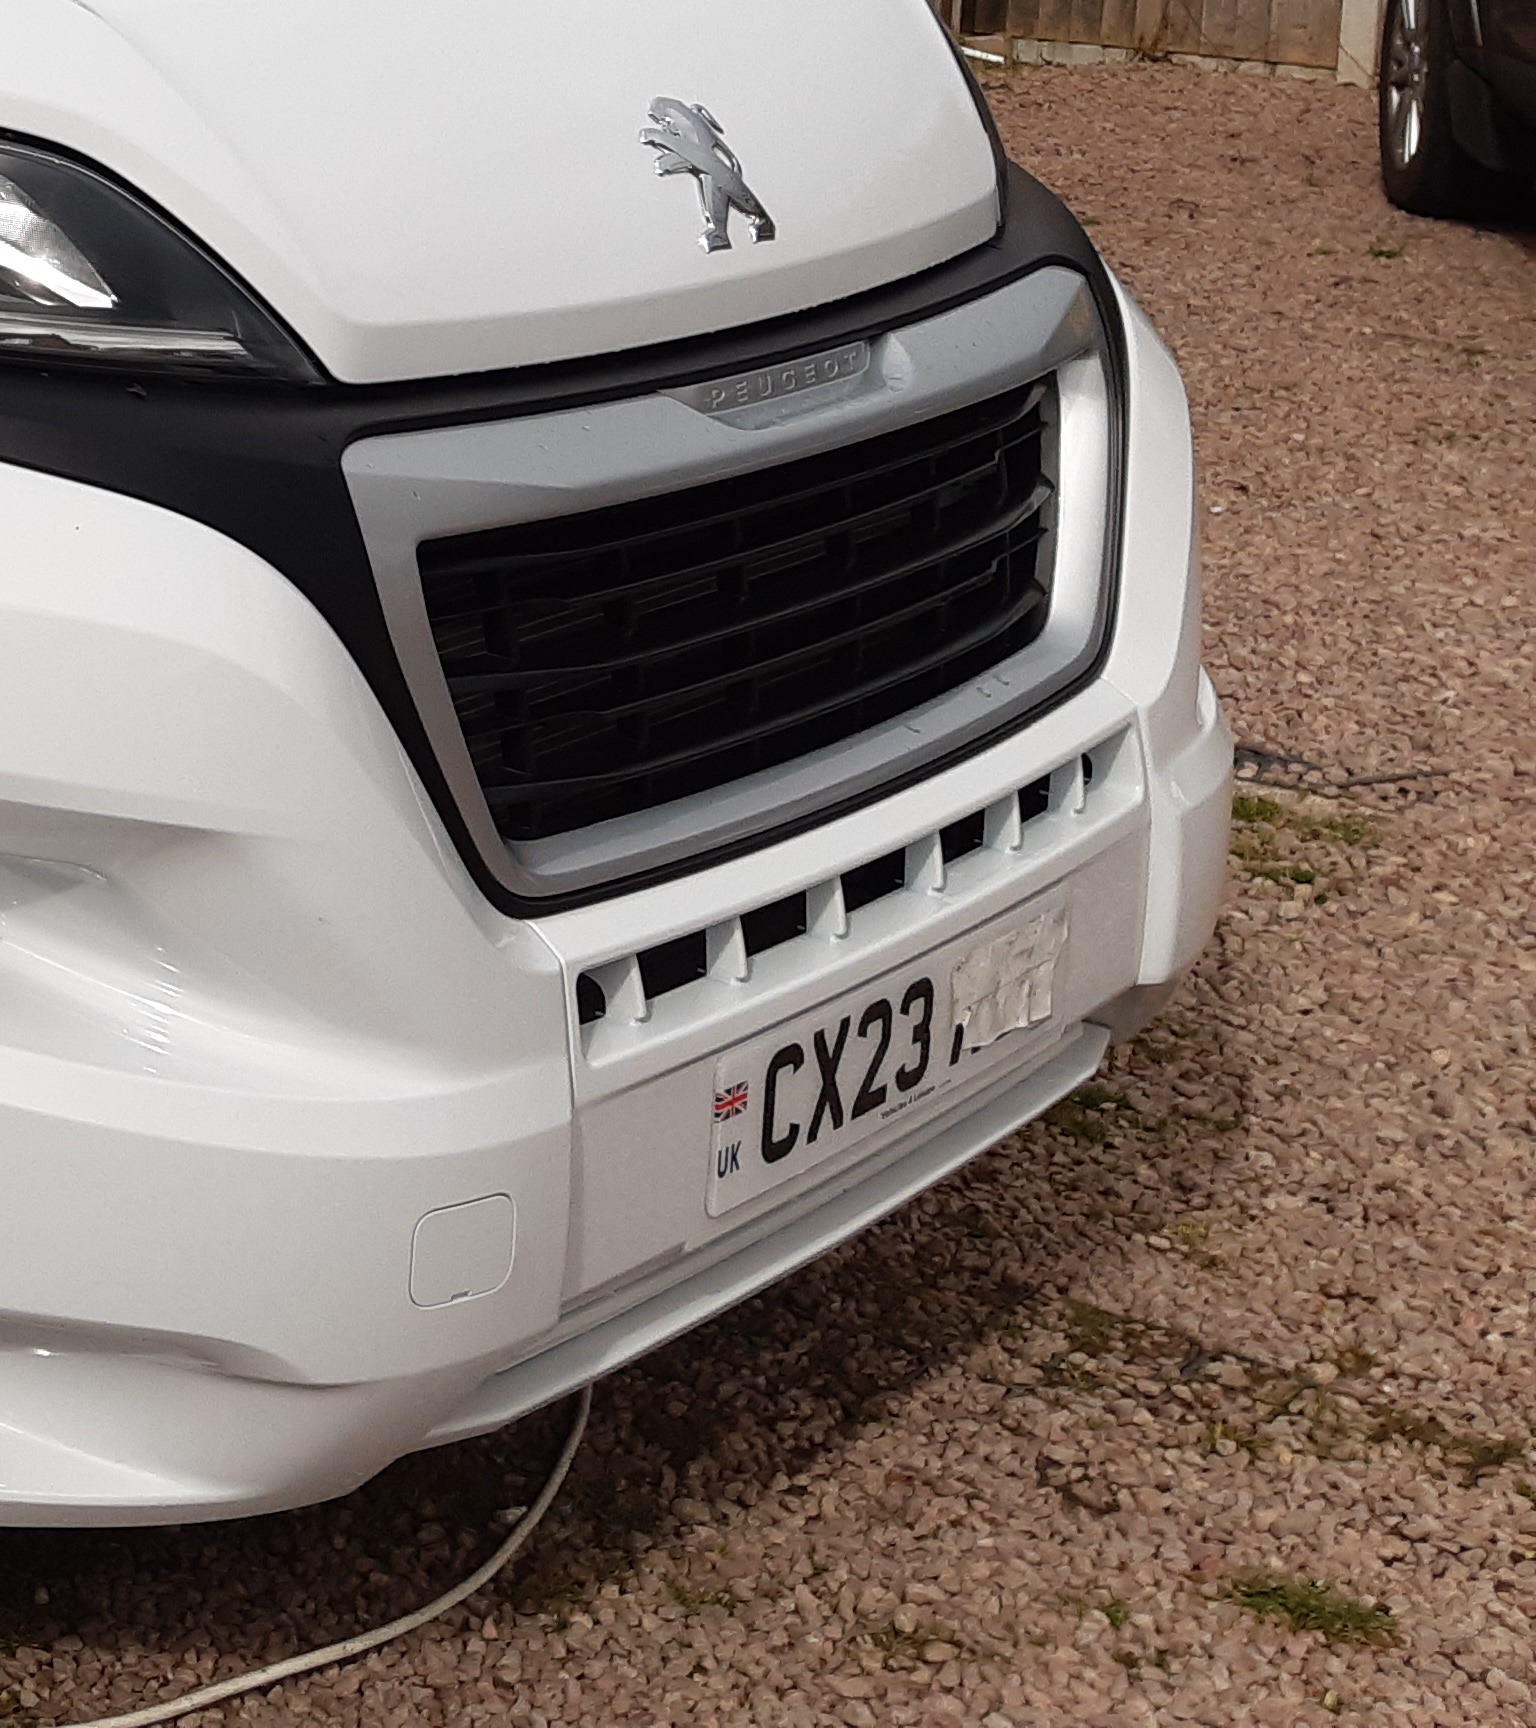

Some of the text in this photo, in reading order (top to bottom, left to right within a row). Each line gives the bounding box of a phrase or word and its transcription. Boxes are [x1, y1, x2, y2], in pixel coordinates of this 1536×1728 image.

[704, 351, 858, 409] PEUGEOT
[761, 976, 935, 1164] CX23
[717, 1140, 743, 1178] UK
